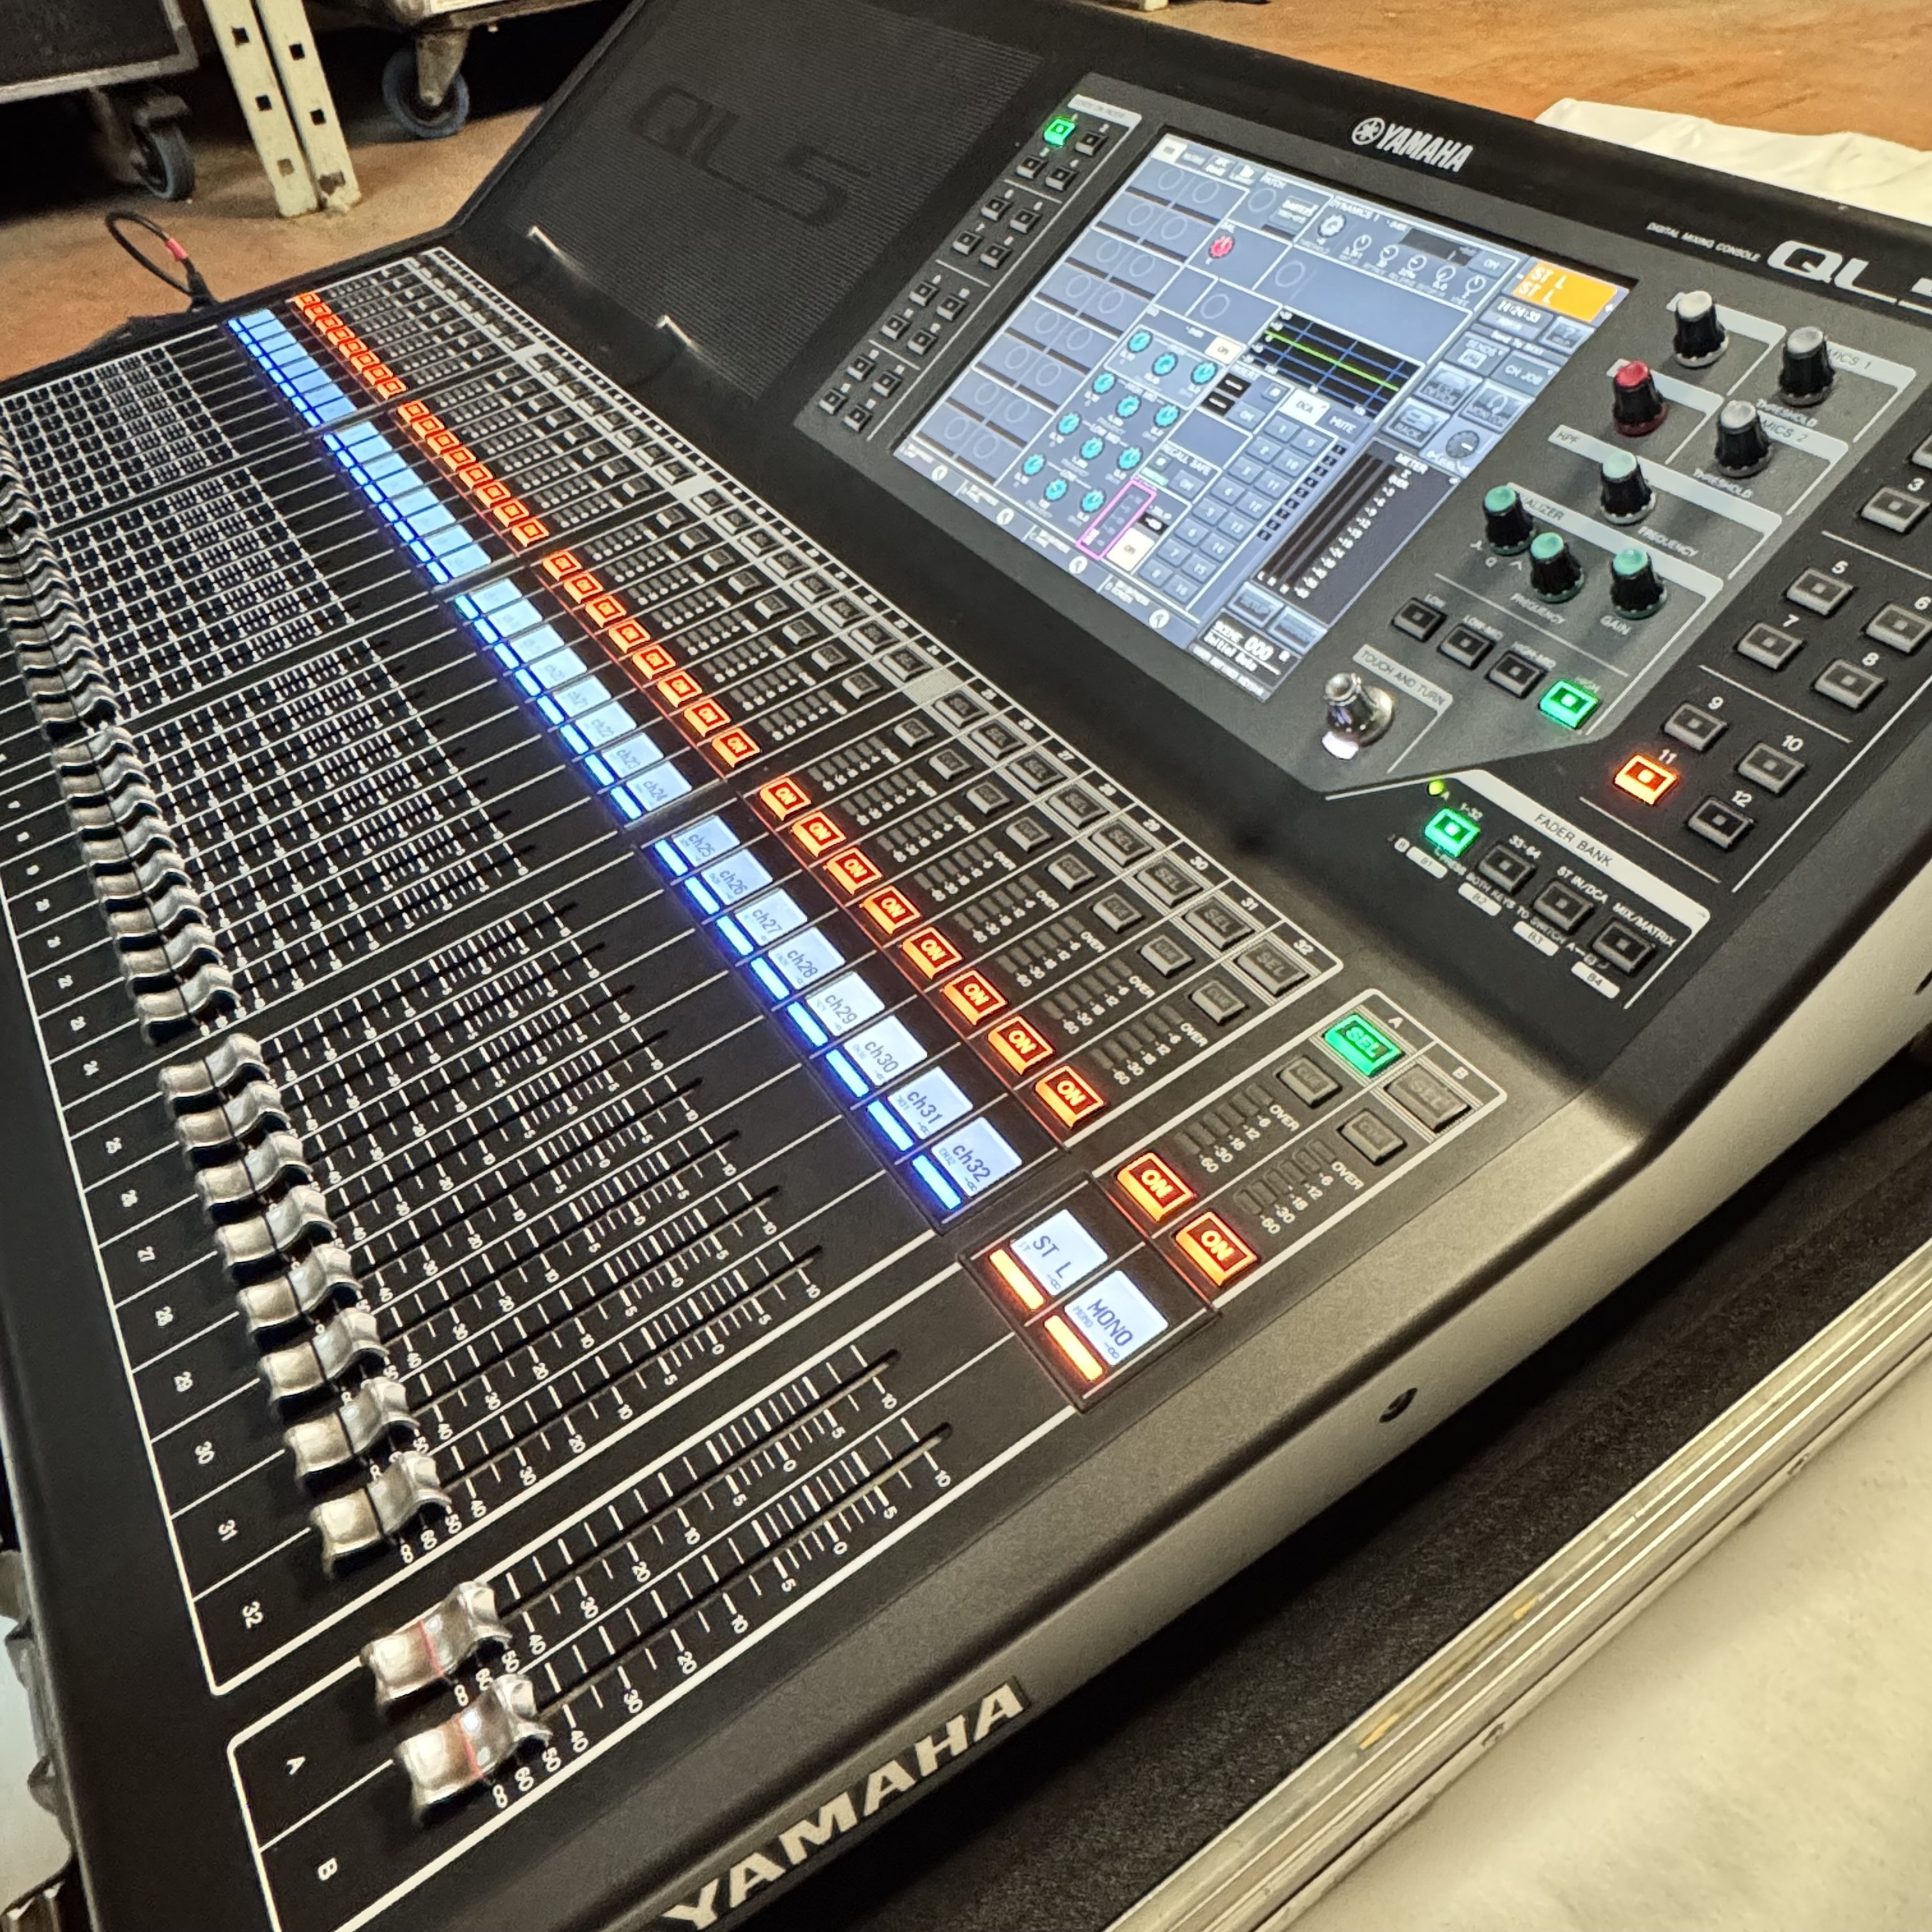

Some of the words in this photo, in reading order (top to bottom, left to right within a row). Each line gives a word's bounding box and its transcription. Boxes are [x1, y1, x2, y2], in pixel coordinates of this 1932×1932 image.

[1376, 123, 1473, 172] YAMAHA
[1716, 238, 1761, 262] CONSOLE
[1531, 266, 1554, 283] ST
[1555, 275, 1568, 290] L
[1517, 281, 1540, 297] ST
[1542, 289, 1556, 305] L
[1756, 398, 1819, 427] THRESHOLD
[1328, 415, 1358, 435] MUTE
[1797, 433, 1809, 444] 2
[1693, 468, 1754, 499] THRESHOLD
[1907, 478, 1924, 491] 3
[1637, 526, 1698, 556] FREQUENCY
[1831, 560, 1848, 574] 5
[1425, 593, 1446, 609] LOW
[1510, 593, 1566, 625] FREQUENCY
[1915, 597, 1931, 610] 6
[1600, 616, 1630, 635] GAIN
[1783, 615, 1800, 628] 7
[1862, 652, 1879, 666] 8
[1360, 650, 1392, 674] TOUCH
[1393, 670, 1415, 687] AND
[1416, 683, 1446, 707] TURN
[1708, 696, 1724, 710] 9
[1781, 735, 1804, 751] 10
[1659, 749, 1678, 764] 11
[775, 786, 797, 805] ON
[1731, 790, 1752, 808] 12
[809, 822, 832, 841] ON
[1533, 813, 1575, 843] FADER
[1577, 839, 1614, 868] BANK
[688, 833, 715, 857] ch25
[1508, 834, 1542, 860] 33-64
[844, 859, 868, 879] ON
[1190, 856, 1209, 871] 30
[719, 870, 748, 896] ch26
[1556, 866, 1572, 880] ST
[1572, 871, 1609, 905] IN/DCA
[1241, 897, 1259, 911] 31
[1466, 872, 1491, 893] BOTH
[1490, 888, 1516, 910] KEYS
[1516, 906, 1531, 920] TO
[1472, 893, 1488, 907] B2
[881, 898, 905, 919] ON
[1204, 907, 1230, 933] SEL
[752, 908, 783, 933] ch27
[1612, 902, 1676, 947] MIX/MATRIX
[921, 939, 946, 962] ON
[1293, 939, 1314, 956] 32
[786, 949, 818, 978] ch28
[1257, 950, 1286, 978] SEL
[1129, 974, 1156, 999] OVER
[1586, 973, 1603, 988] B4
[963, 983, 990, 1007] ON
[824, 993, 858, 1025] ch29
[1387, 1016, 1404, 1029] A
[1008, 1029, 1038, 1056] ON
[1180, 1023, 1208, 1047] OVER
[1346, 1025, 1381, 1057] SEL
[864, 1039, 900, 1074] ch30
[1452, 1068, 1469, 1082] B
[1056, 1080, 1084, 1107] ON
[1408, 1077, 1445, 1110] SEL
[907, 1089, 944, 1124] ch31
[1270, 1103, 1301, 1133] OVER
[952, 1143, 991, 1183] ch32
[1140, 1169, 1173, 1200] ON
[1319, 1172, 1334, 1186] -6
[1331, 1161, 1364, 1191] OVER
[1304, 1183, 1323, 1200] -12
[1260, 1214, 1280, 1234] -60
[1274, 1203, 1296, 1223] -30
[1031, 1234, 1059, 1258] ST
[1055, 1261, 1074, 1280] L
[1200, 1229, 1232, 1262] ON
[1086, 1298, 1134, 1347] MONO
[882, 1393, 897, 1409] 10
[832, 1425, 846, 1439] 5
[194, 1441, 215, 1465] 30
[783, 1459, 797, 1472] 0
[935, 1471, 951, 1487] 10
[733, 1494, 746, 1506] 5
[884, 1505, 898, 1519] 5
[218, 1519, 238, 1542] 31
[684, 1527, 700, 1545] 10
[834, 1541, 848, 1555] 0
[632, 1562, 650, 1582] 20
[781, 1578, 796, 1593] 5
[241, 1601, 264, 1630] 32
[580, 1597, 599, 1618] 30
[731, 1614, 749, 1634] 10
[528, 1634, 546, 1655] 40
[502, 1649, 519, 1671] 50
[677, 1651, 696, 1675] 20
[624, 1689, 643, 1713] 30
[570, 1729, 588, 1752] 40
[286, 1756, 306, 1775] A
[542, 1748, 562, 1772] 50
[515, 1767, 533, 1791] 60
[661, 1682, 1025, 1931] YAMAHA
[318, 1857, 338, 1880] B
